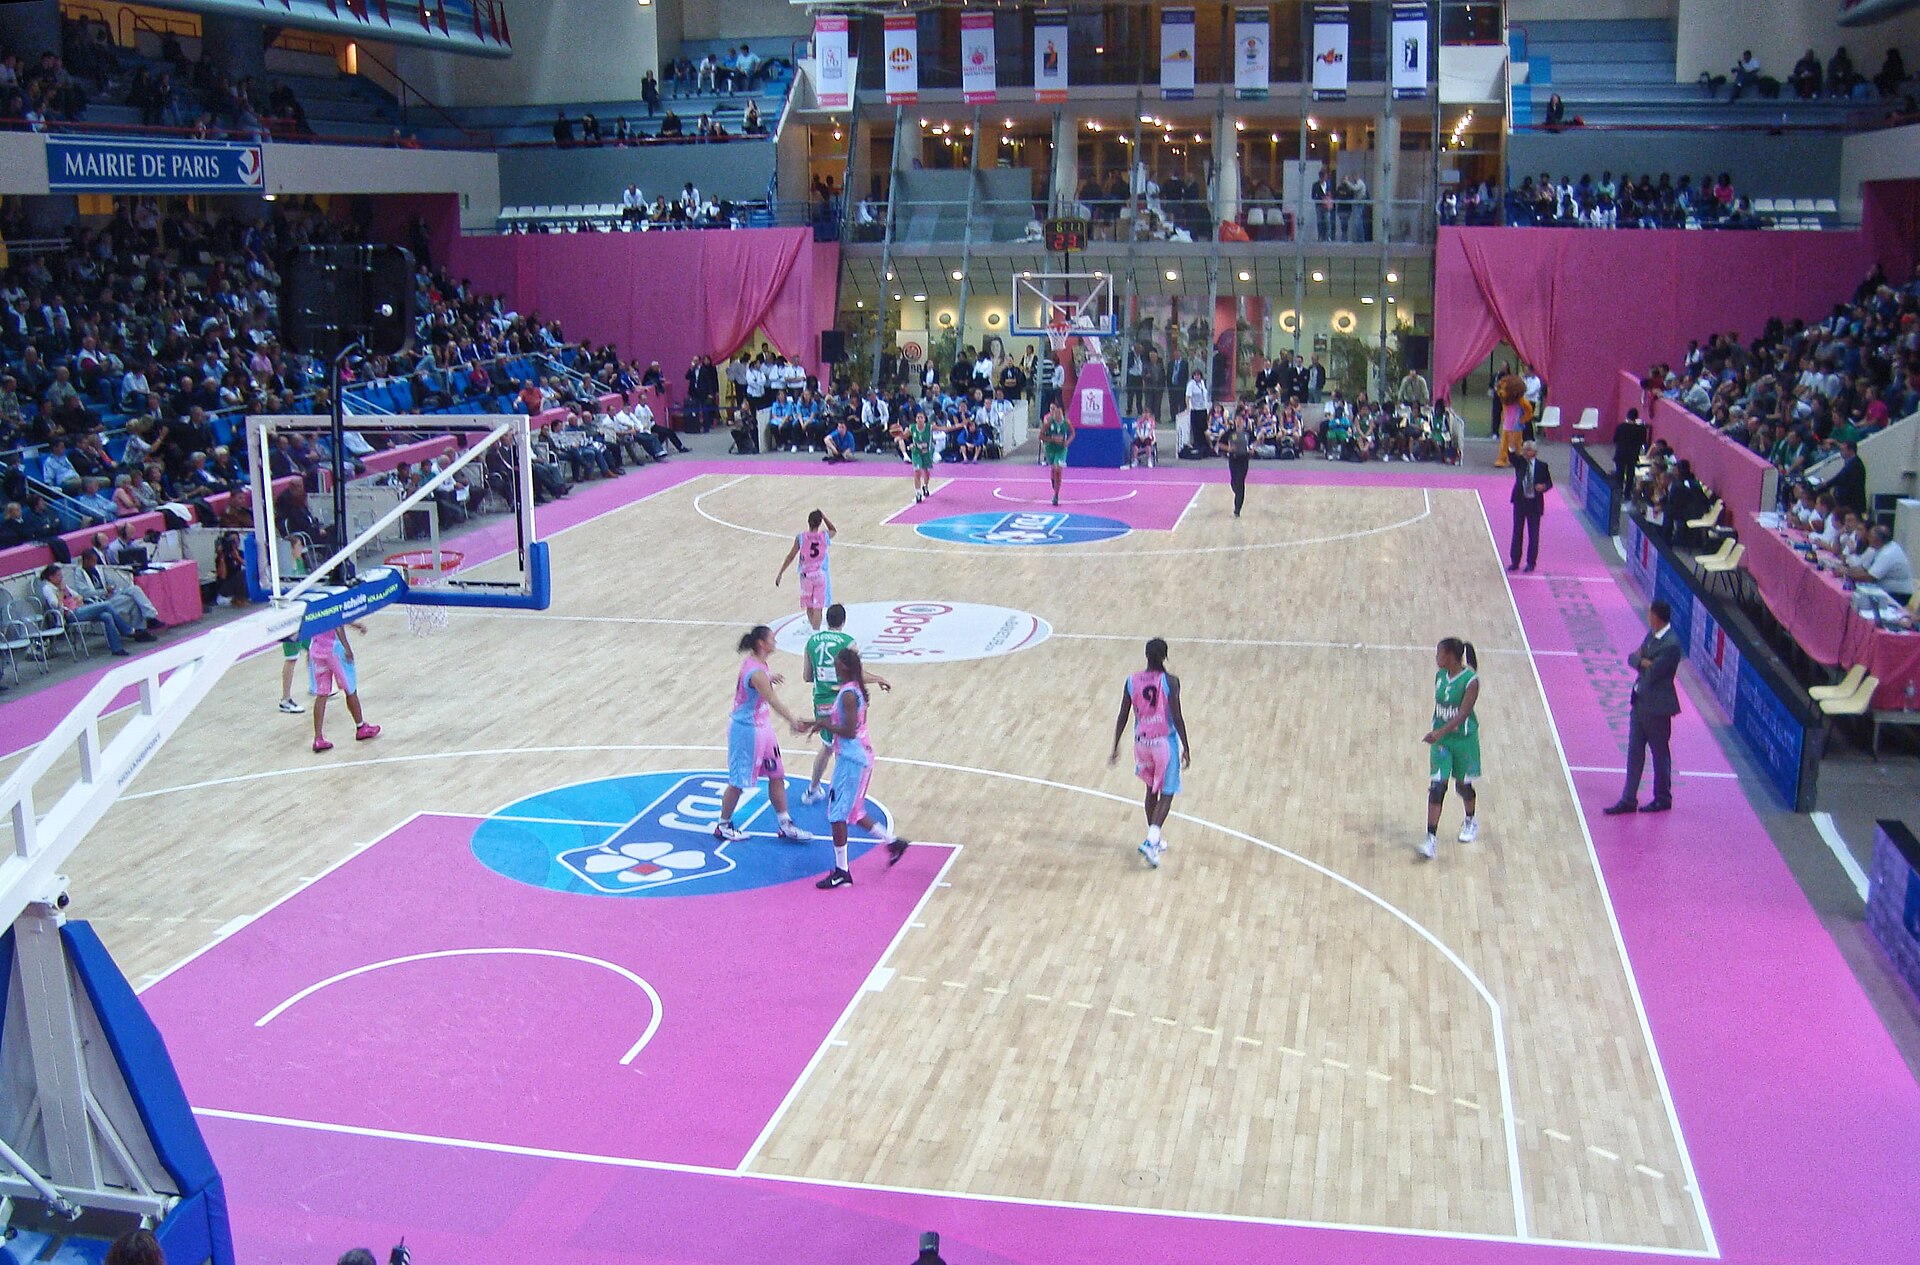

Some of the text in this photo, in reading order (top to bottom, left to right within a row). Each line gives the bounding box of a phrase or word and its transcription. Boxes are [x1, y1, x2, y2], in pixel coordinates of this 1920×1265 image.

[66, 152, 220, 178] MAIRIE DE PARIS
[810, 542, 820, 558] 5
[872, 603, 953, 643] Open
[814, 641, 837, 666] 15
[1142, 685, 1157, 708] 9
